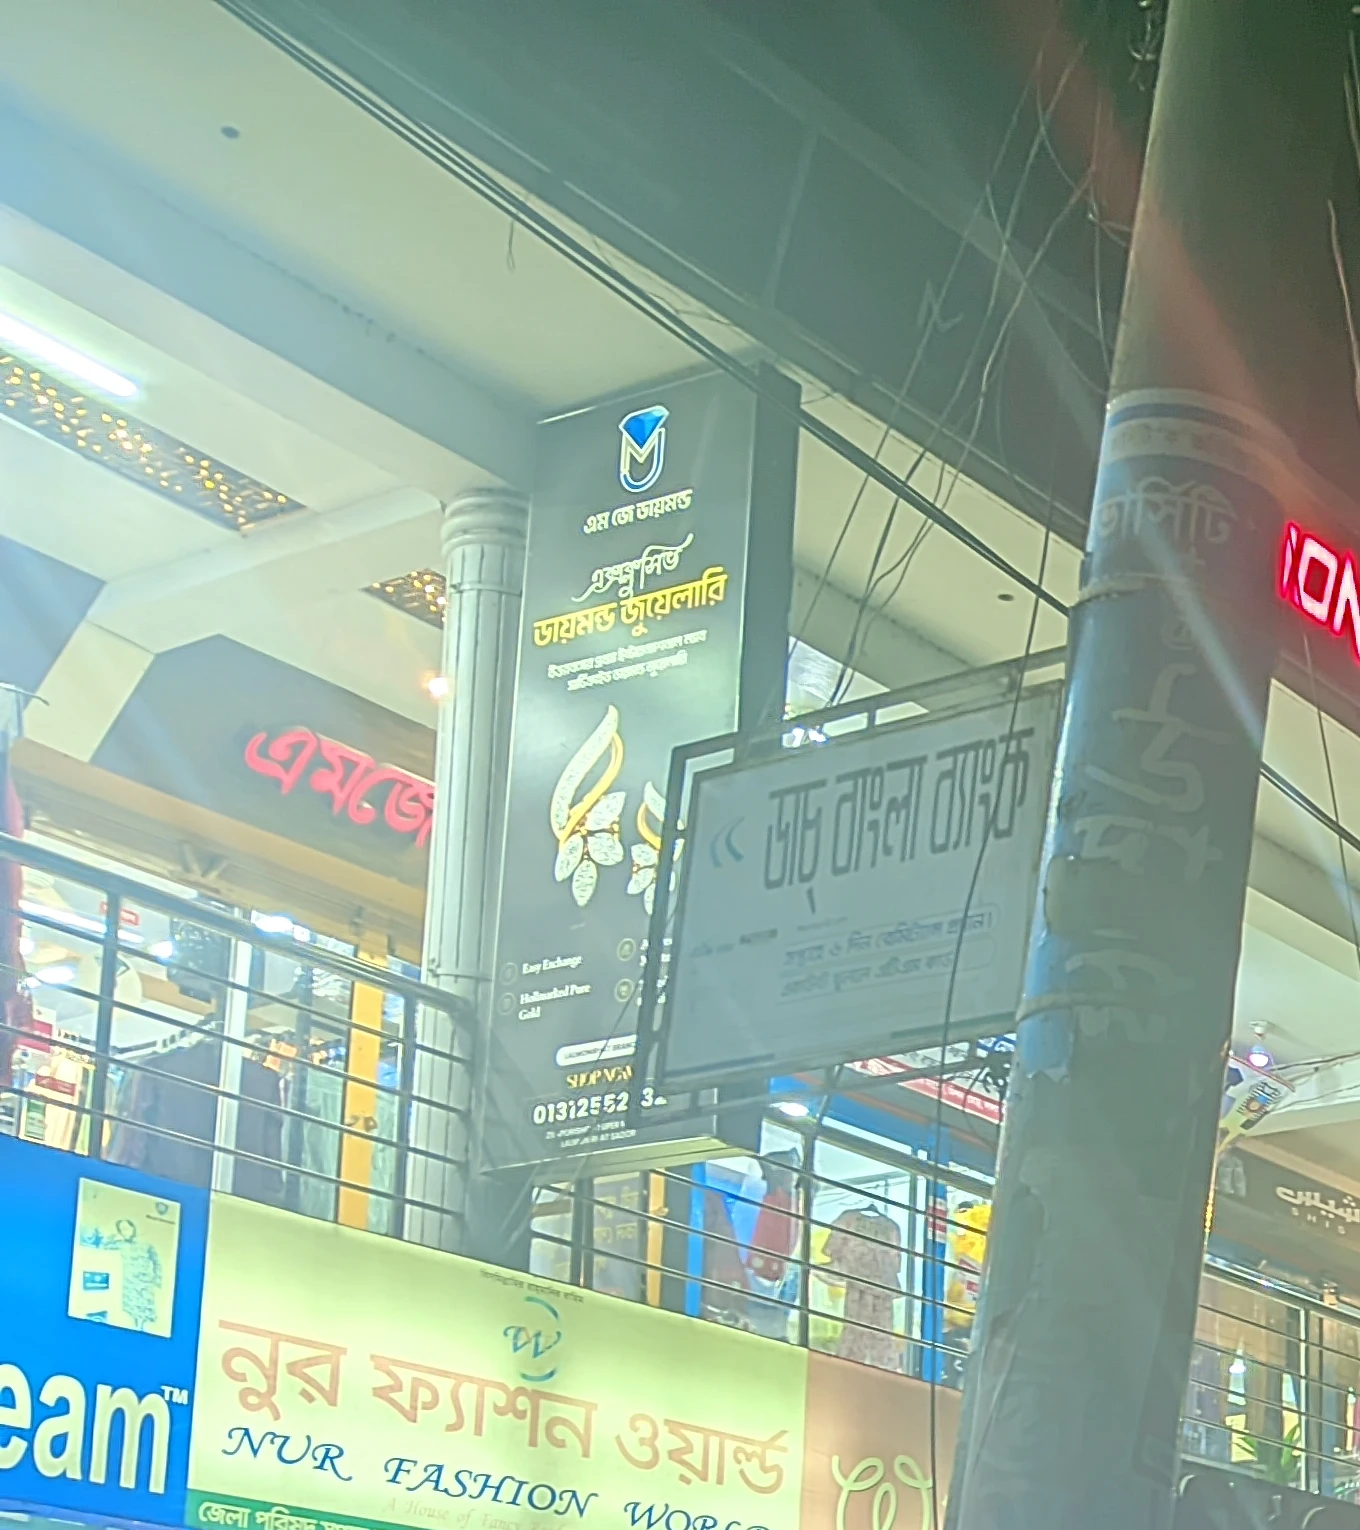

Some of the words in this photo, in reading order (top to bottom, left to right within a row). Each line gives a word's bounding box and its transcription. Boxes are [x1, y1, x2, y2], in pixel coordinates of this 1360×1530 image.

[219, 1319, 348, 1422] নুর
[370, 1354, 598, 1459] ফ্যাশন
[198, 1501, 251, 1529] জেলা
[221, 1426, 353, 1482] NUR
[383, 1457, 599, 1518] FASHION
